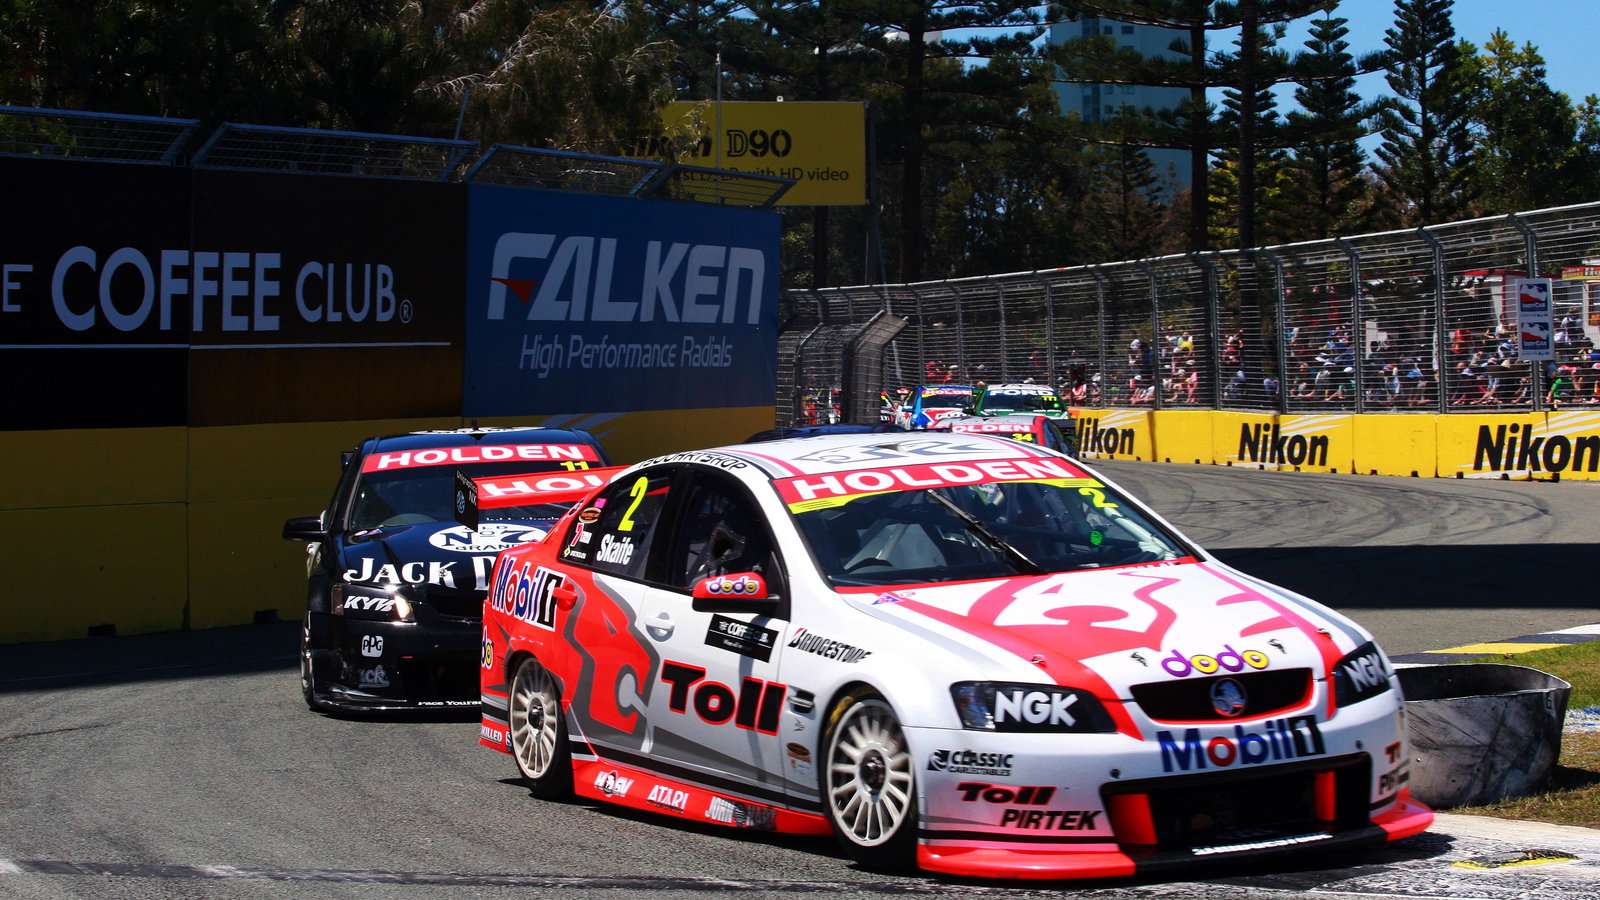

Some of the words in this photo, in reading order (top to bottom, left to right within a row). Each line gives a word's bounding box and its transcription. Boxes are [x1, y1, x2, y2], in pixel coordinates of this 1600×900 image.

[726, 129, 792, 158] D90
[780, 168, 803, 181] HD
[807, 167, 849, 181] video
[51, 245, 281, 331] COFFEE
[295, 261, 397, 323] CLUB
[486, 232, 766, 325] FALKEN
[519, 335, 563, 378] High
[566, 335, 677, 369] Performance
[680, 336, 733, 368] Radials
[952, 425, 1031, 433] OLDEN
[1013, 433, 1033, 441] 34
[378, 445, 583, 469] HOLDEN
[1239, 423, 1328, 467] Nikon
[1473, 423, 1600, 472] Nikon
[560, 461, 590, 471] 11
[791, 459, 1075, 500] HOLDEN
[618, 476, 649, 531] 2
[1078, 487, 1118, 508] 2
[596, 533, 634, 565] Skaife
[343, 557, 458, 590] JACK
[706, 575, 759, 595] dodo
[343, 596, 396, 612] KYB
[362, 635, 382, 653] PPG
[786, 628, 875, 664] BRIDGESTONE
[1160, 643, 1269, 677] dodo
[1343, 652, 1388, 692] NGK
[661, 659, 787, 737] Toll
[993, 690, 1079, 727] NGK
[481, 726, 503, 743] KILLED
[951, 750, 1014, 768] CLASSIC
[648, 784, 690, 810] ATARI
[956, 782, 1057, 806] Toll
[1001, 808, 1103, 830] PIRTEK
